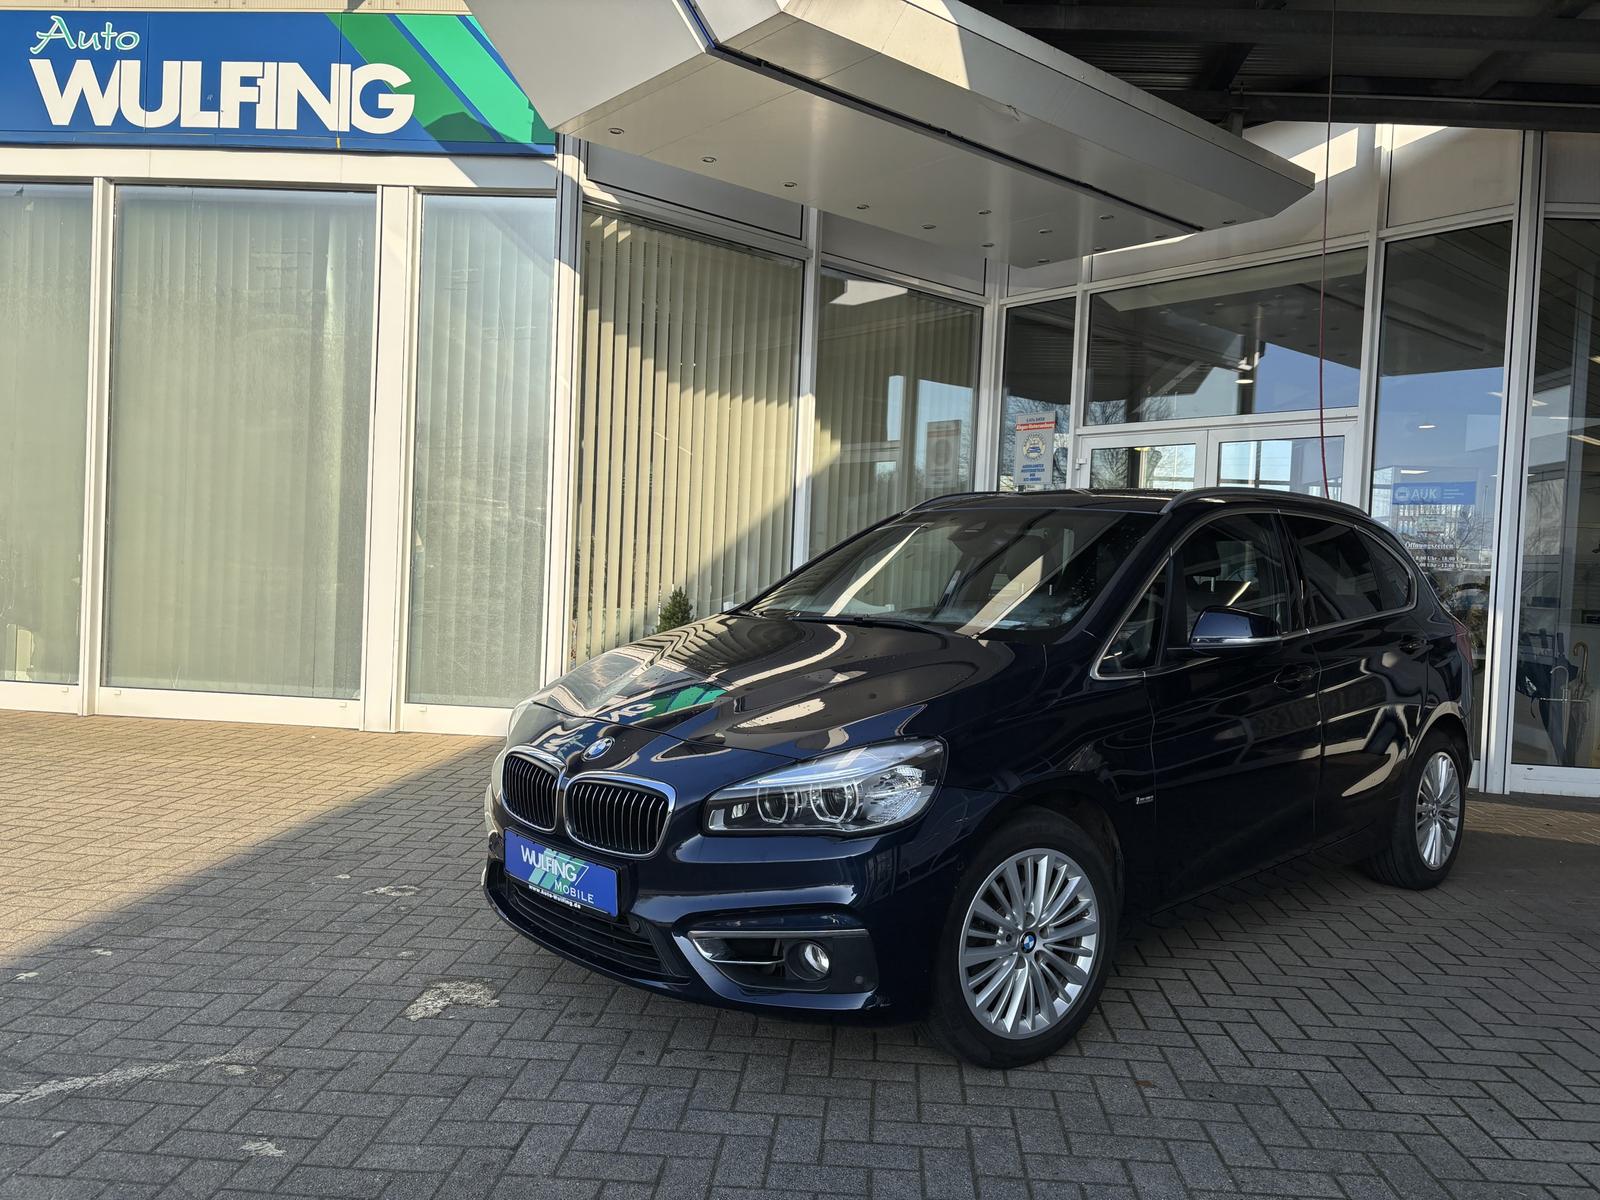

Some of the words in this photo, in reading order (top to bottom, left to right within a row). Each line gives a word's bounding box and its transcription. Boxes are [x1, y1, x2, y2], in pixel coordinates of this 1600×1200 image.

[29, 15, 141, 54] Auto
[29, 59, 415, 135] WULFING
[1411, 487, 1438, 500] AUK
[520, 844, 578, 882] WULFING
